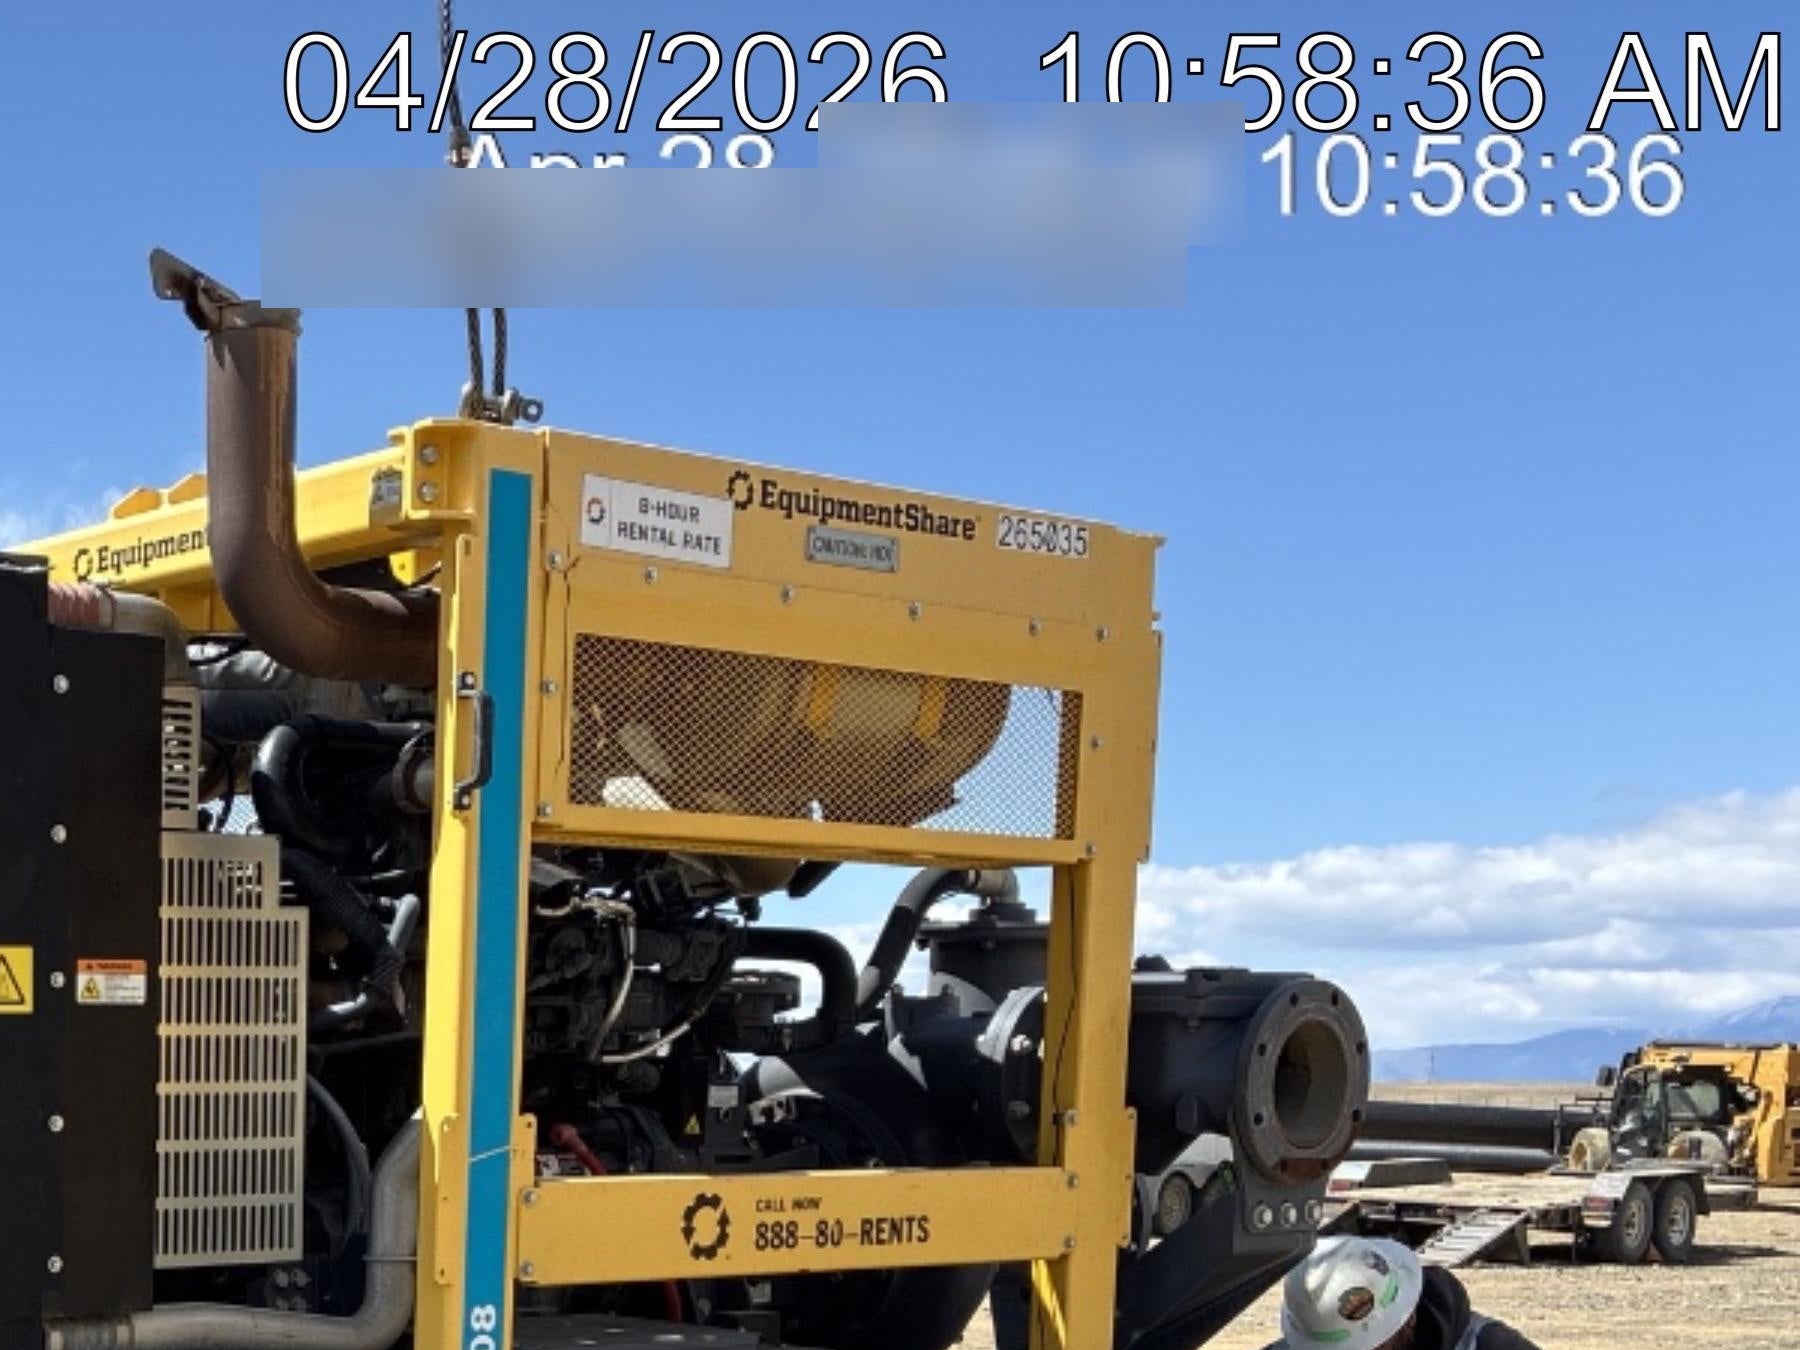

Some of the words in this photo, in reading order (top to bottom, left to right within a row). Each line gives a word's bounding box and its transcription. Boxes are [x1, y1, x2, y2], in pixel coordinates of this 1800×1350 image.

[638, 497, 700, 523] 8-HOUR
[760, 479, 977, 541] EquipmentShare
[96, 529, 205, 576] Equipmen
[617, 520, 678, 547] RENTAL
[682, 531, 722, 555] RATE
[755, 1198, 787, 1213] CALL
[791, 1196, 823, 1211] NOW
[755, 1214, 930, 1252] 888-80-RENTS
